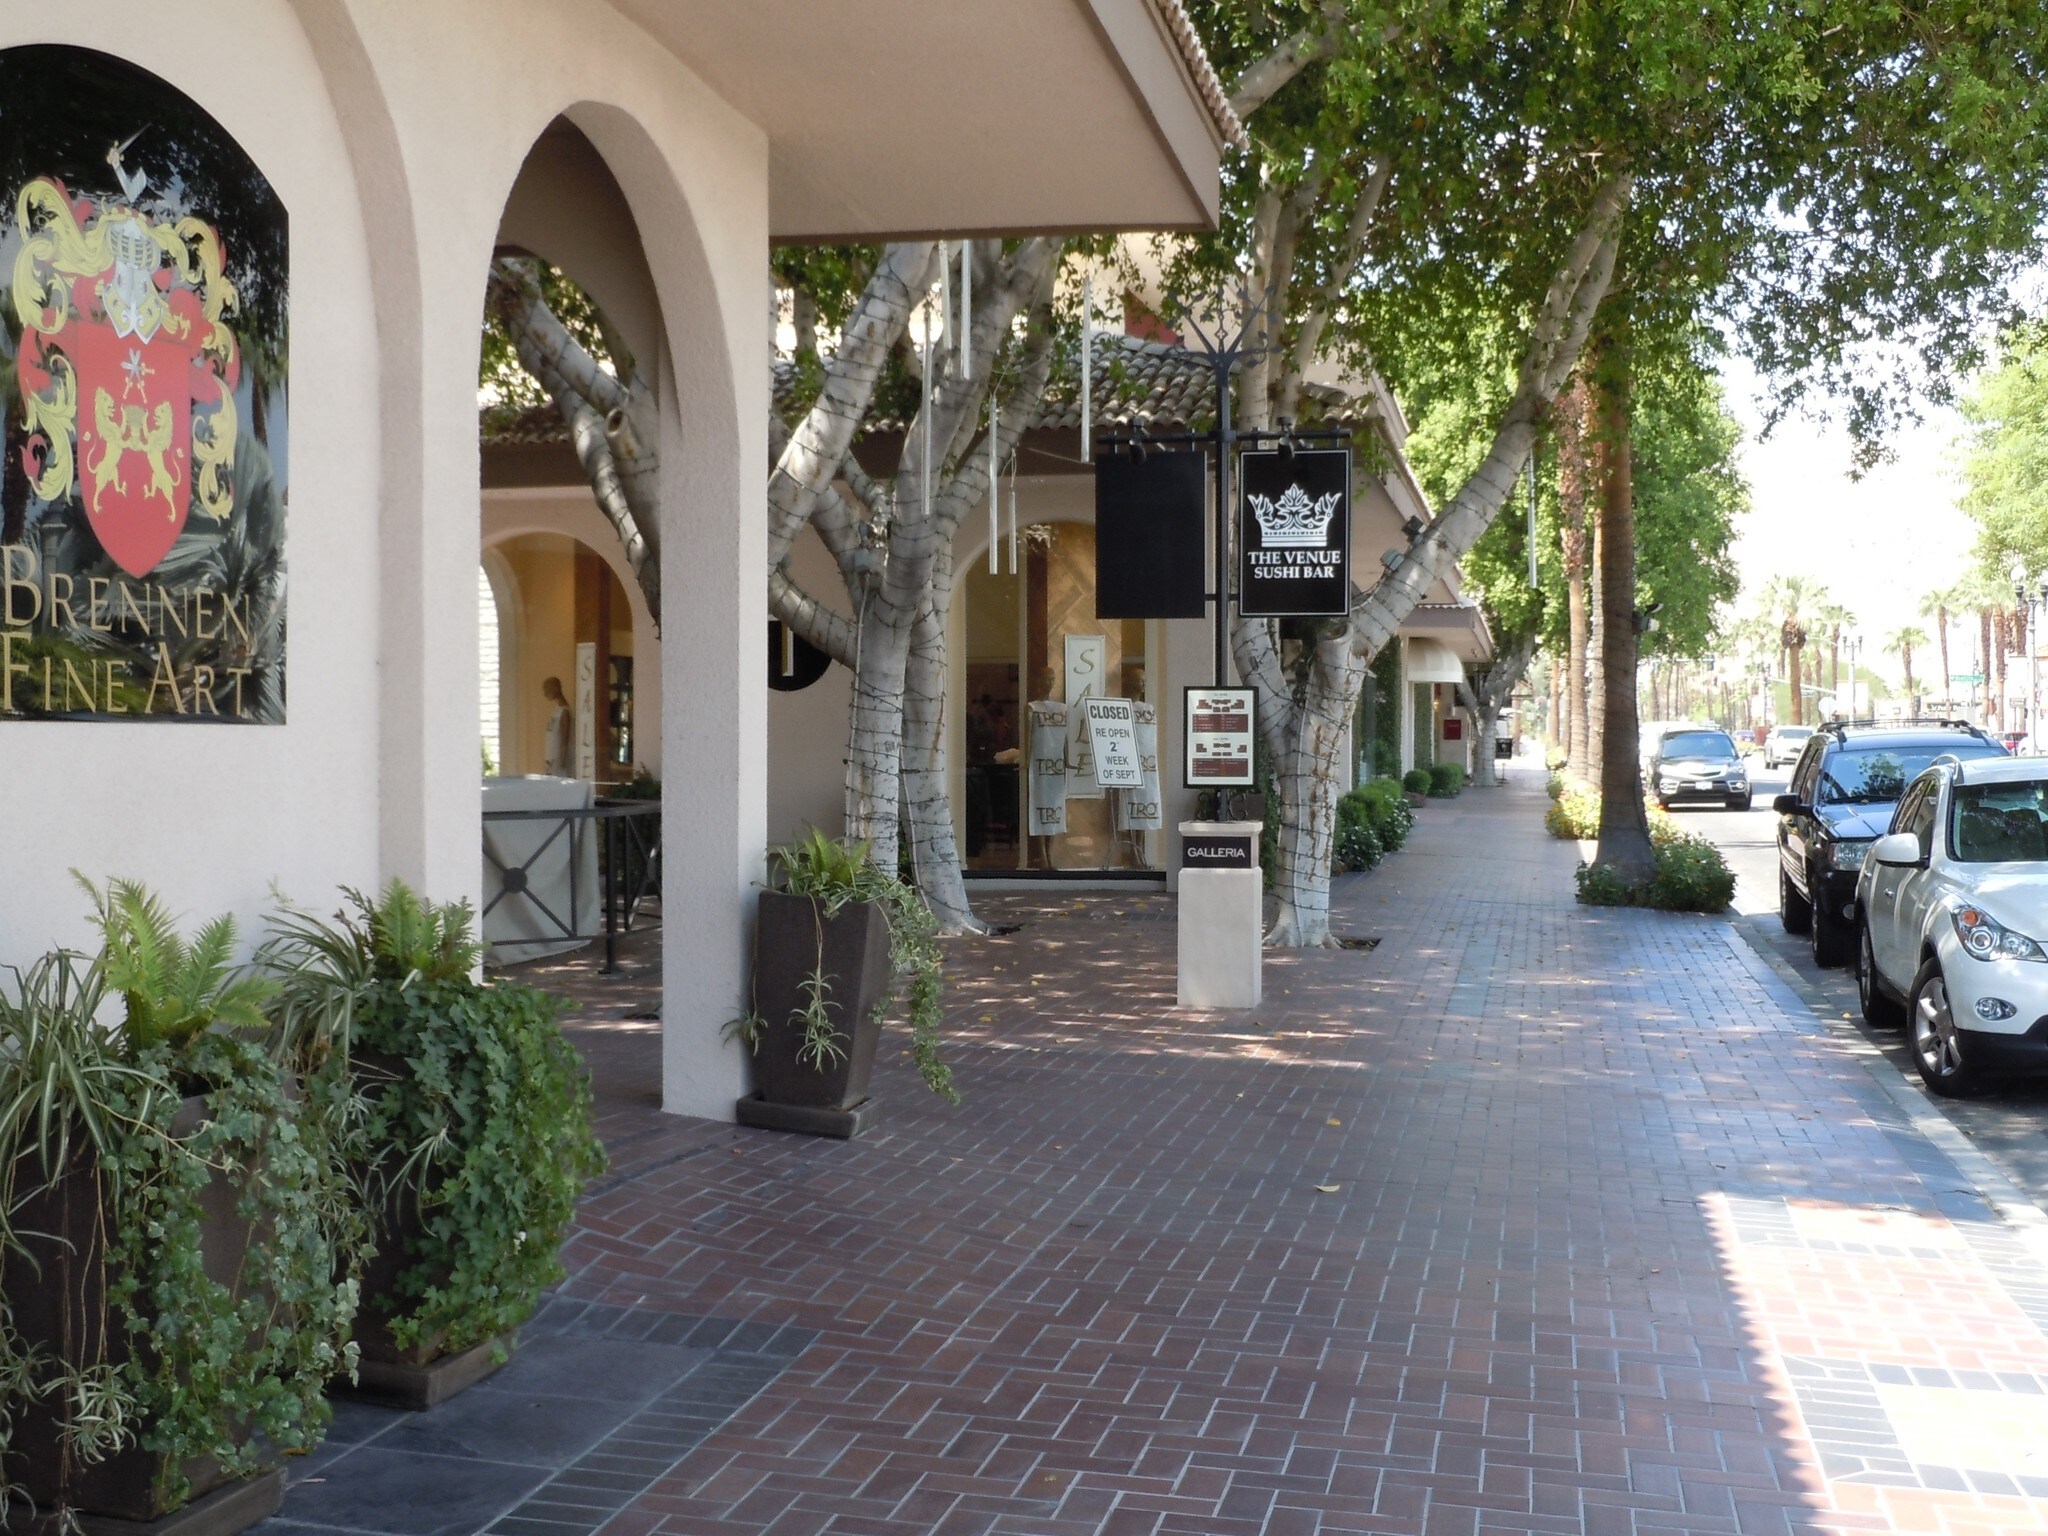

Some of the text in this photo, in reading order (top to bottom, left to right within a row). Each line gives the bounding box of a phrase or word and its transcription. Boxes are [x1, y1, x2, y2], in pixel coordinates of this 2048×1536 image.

[1247, 550, 1341, 565] THE VENUE
[1254, 566, 1335, 579] SUSHI BAR
[1, 545, 251, 642] BRENNEN
[1, 631, 252, 716] FINE ART
[1090, 704, 1130, 720] CLOSED
[1095, 728, 1130, 738] RE OPEN
[1105, 756, 1129, 766] WEEK
[1103, 769, 1135, 780] OF SEPT
[1187, 847, 1246, 858] GALLERIA
